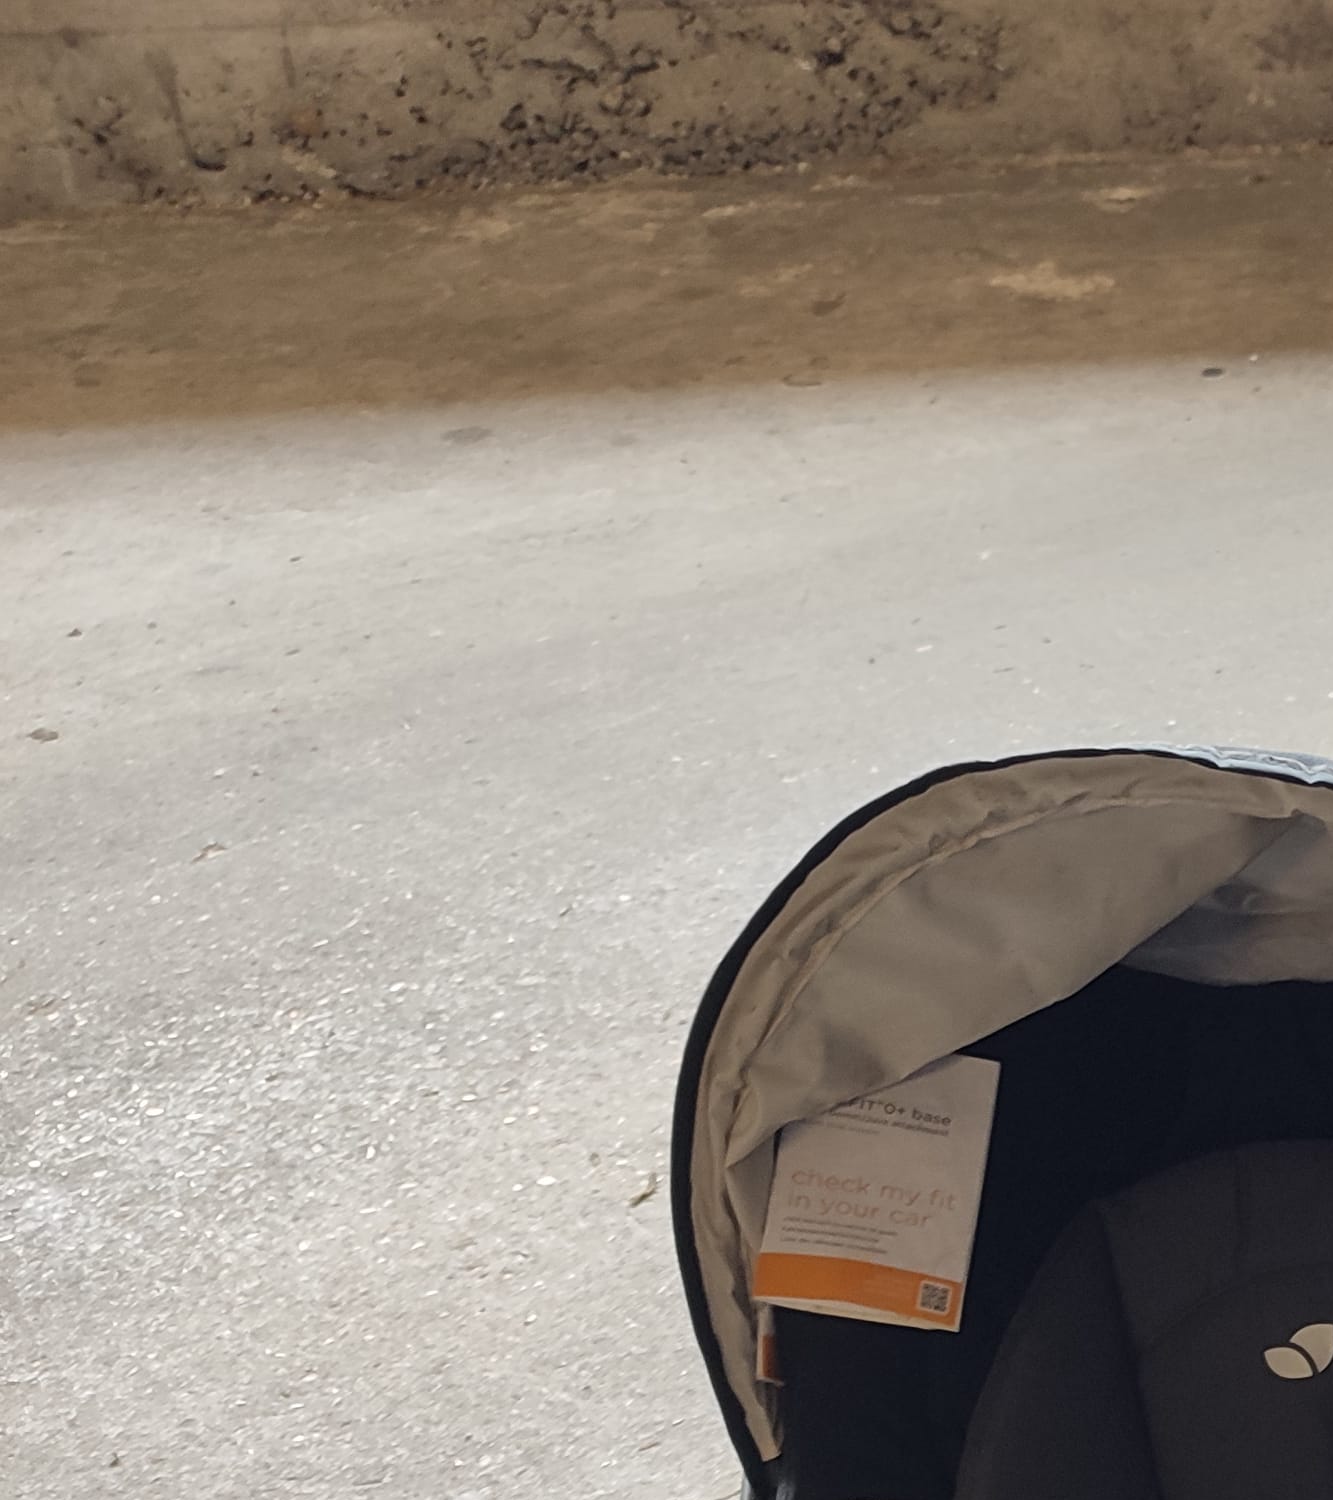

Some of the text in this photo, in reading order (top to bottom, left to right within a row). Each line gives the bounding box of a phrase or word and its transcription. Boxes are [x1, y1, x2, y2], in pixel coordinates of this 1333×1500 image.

[911, 1107, 952, 1127] base
[787, 1190, 811, 1209] in
[818, 1199, 880, 1217] your
[888, 1209, 933, 1228] car
[791, 1169, 956, 1211] check my fit
